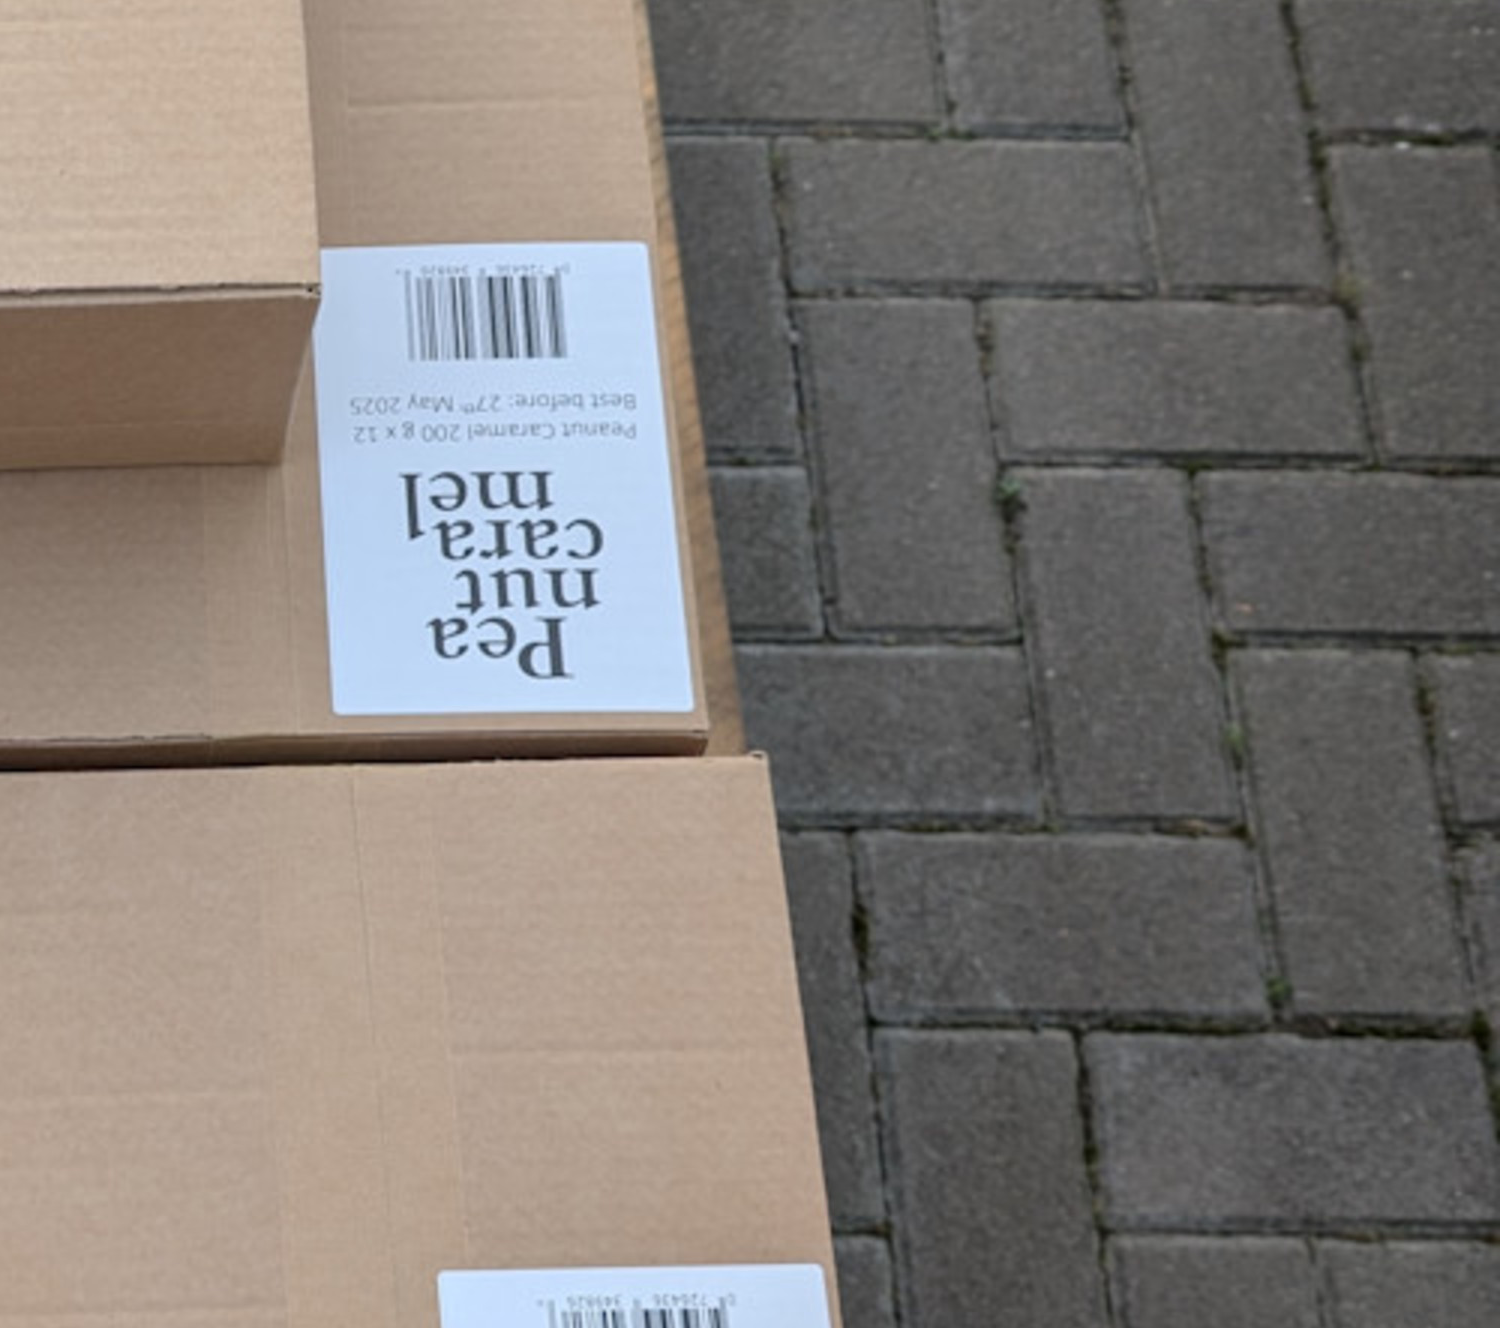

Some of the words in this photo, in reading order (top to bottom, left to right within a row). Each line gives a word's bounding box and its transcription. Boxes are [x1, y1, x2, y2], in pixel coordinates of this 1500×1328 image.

[349, 396, 401, 416] 2025
[407, 393, 454, 414] May
[459, 393, 501, 415] 27th
[508, 393, 585, 413] before:
[590, 392, 637, 411] Best
[353, 425, 378, 444] 12
[386, 426, 396, 439] x
[401, 420, 415, 440] g
[421, 423, 461, 444] 200
[466, 422, 556, 442] Caramel
[561, 421, 637, 440] Peanut
[399, 472, 555, 540] mel
[432, 519, 604, 560] cara
[455, 568, 600, 614] nut
[426, 617, 572, 678] Pea
